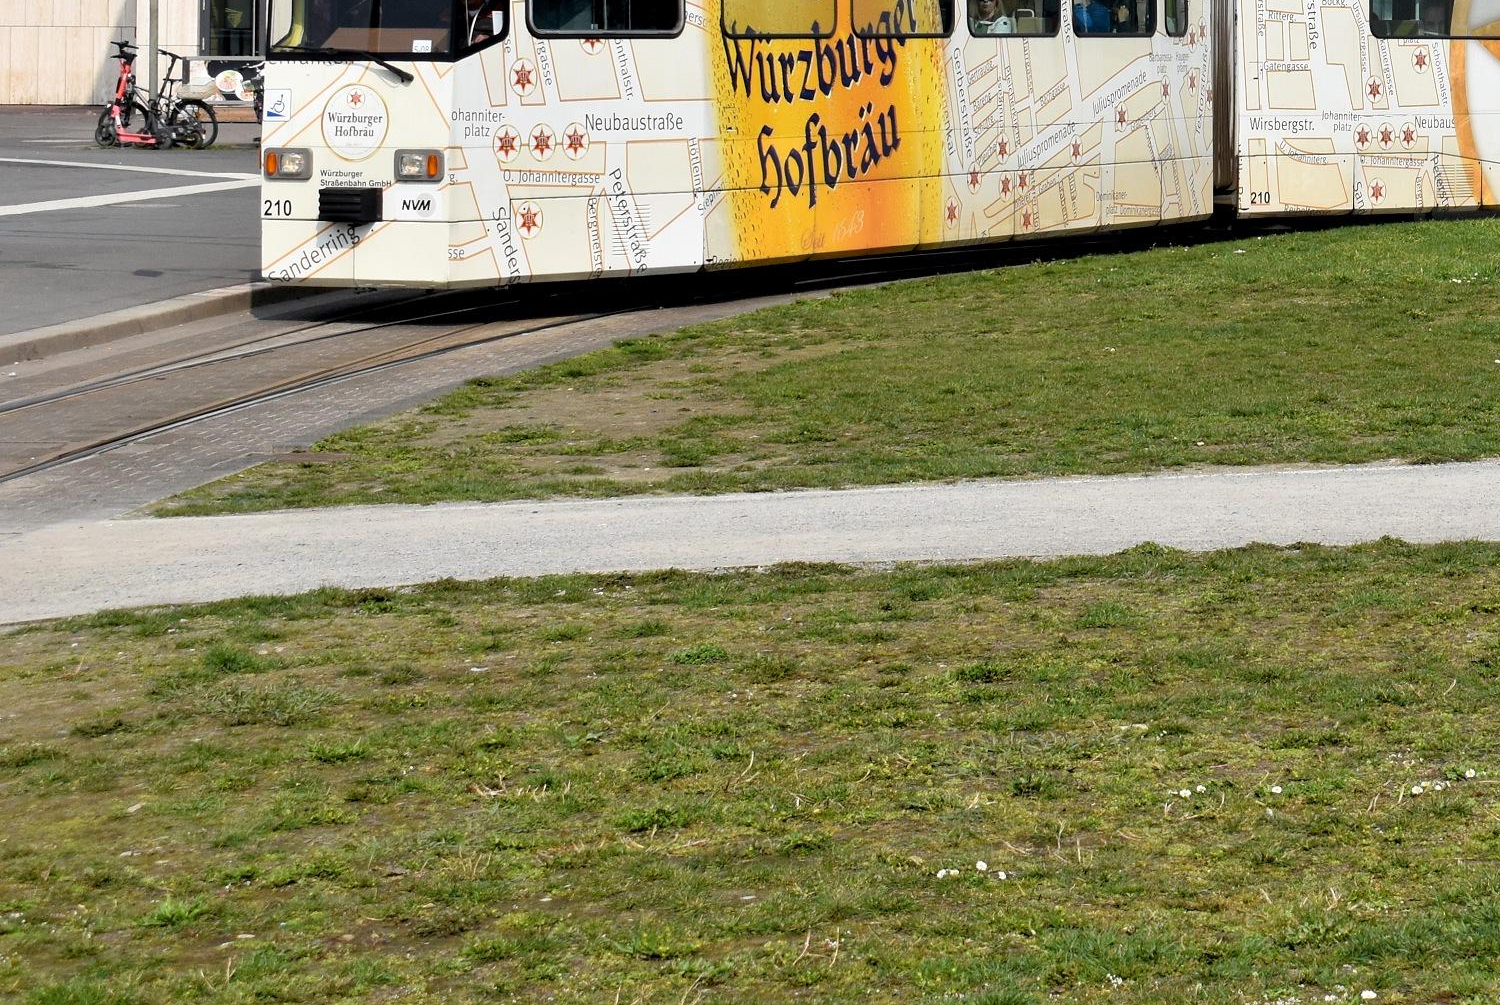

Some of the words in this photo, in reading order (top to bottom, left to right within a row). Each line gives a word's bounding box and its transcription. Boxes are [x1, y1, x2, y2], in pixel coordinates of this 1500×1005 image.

[953, 47, 974, 158] Gerberstraße
[1091, 70, 1148, 119] Juliuspromenade
[328, 111, 383, 126] Würzburger
[585, 112, 684, 132] Neubaustraße
[1249, 117, 1315, 134] Wirsbergstr.
[334, 125, 374, 137] Hofbräu
[464, 123, 490, 139] platz
[1333, 123, 1352, 132] platz
[1017, 119, 1076, 169] Juliuspromenade
[756, 101, 902, 210] Hofbräu
[320, 169, 363, 180] Würzburger
[518, 170, 601, 186] Johannitergasse
[320, 179, 367, 187] Straßenbahn
[368, 180, 392, 188] GmbH
[401, 199, 432, 212] NVM
[1250, 191, 1271, 205] 210
[263, 199, 292, 217] 210
[268, 225, 361, 283] Sanderring
